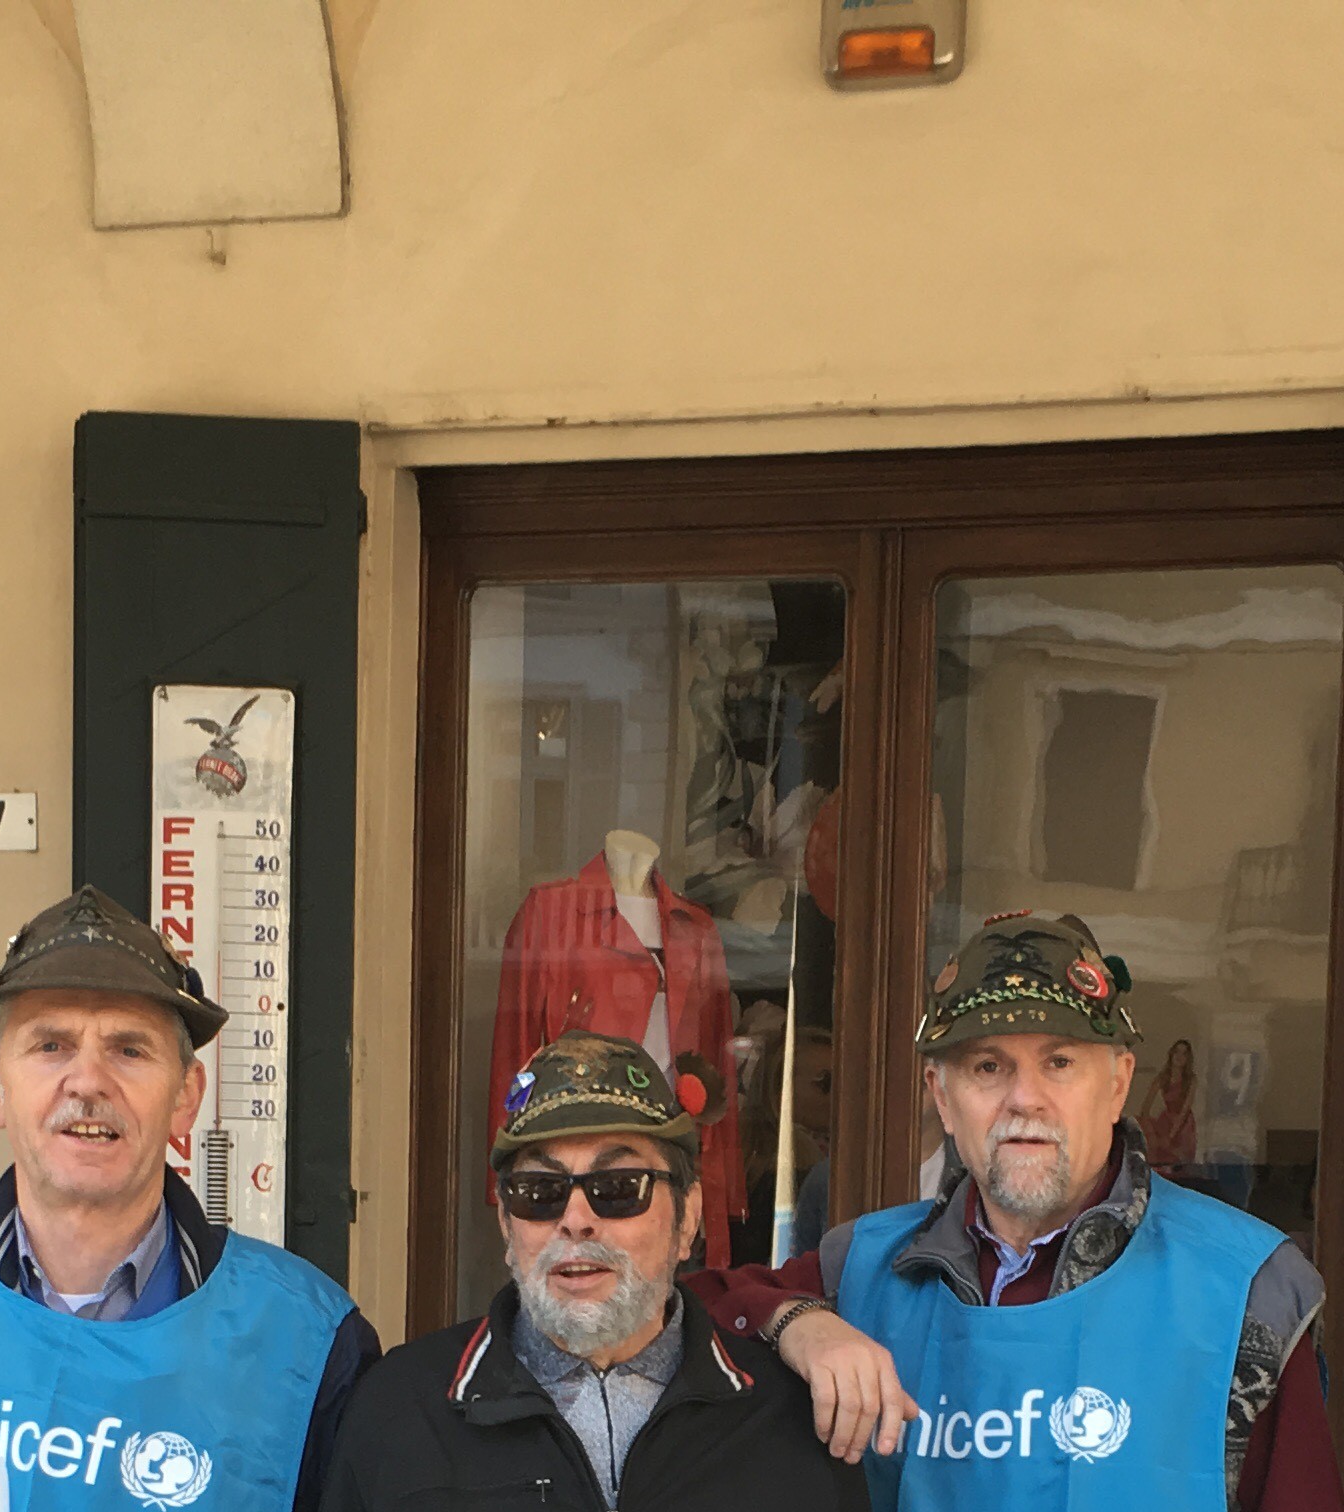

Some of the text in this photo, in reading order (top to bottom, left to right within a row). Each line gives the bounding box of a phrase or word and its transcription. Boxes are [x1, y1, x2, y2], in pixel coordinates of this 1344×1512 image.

[255, 819, 281, 839] 50
[254, 855, 280, 872] 40
[254, 889, 280, 907] 30
[254, 924, 279, 942] 20
[253, 960, 275, 978] 10
[258, 995, 272, 1014] 0
[253, 1029, 274, 1047] 10
[252, 1064, 277, 1082] 20
[251, 1099, 276, 1117] 30
